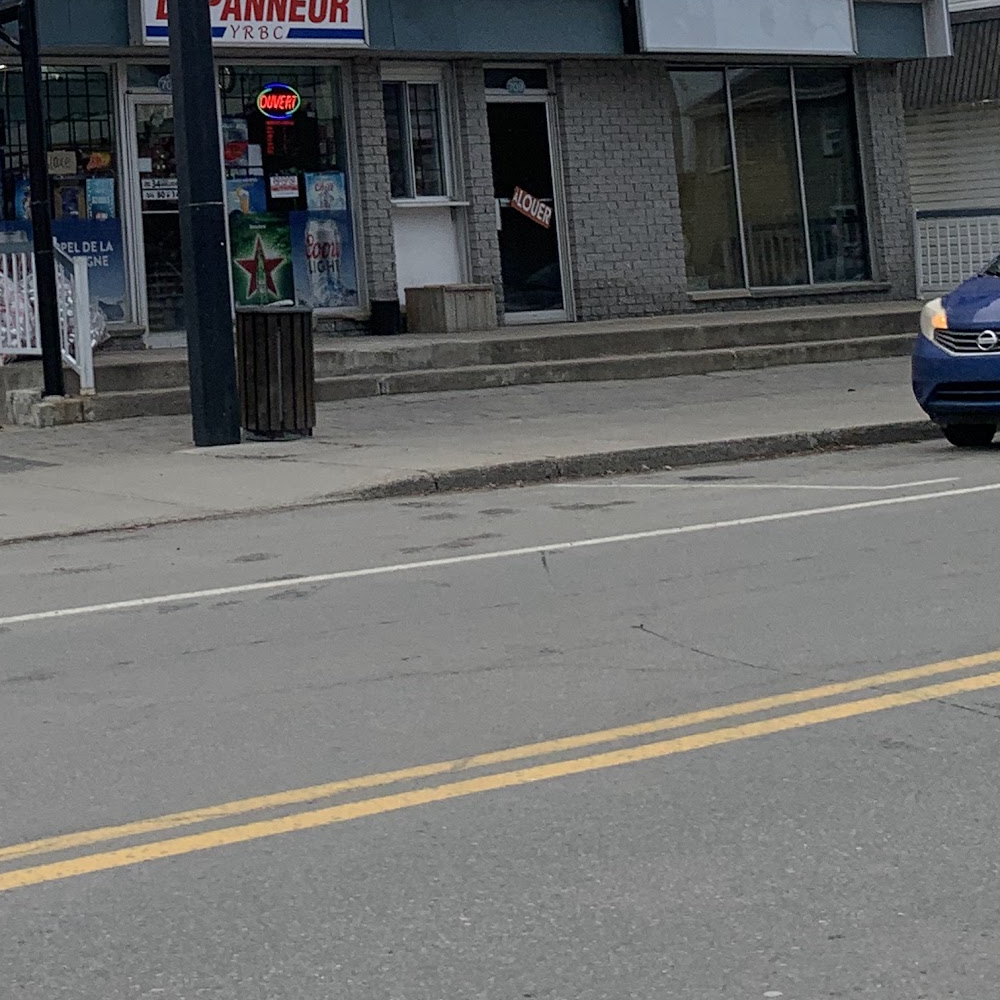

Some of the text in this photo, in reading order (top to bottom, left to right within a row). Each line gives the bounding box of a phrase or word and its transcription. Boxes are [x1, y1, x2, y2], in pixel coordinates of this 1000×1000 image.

[230, 24, 284, 40] YRBC
[259, 94, 298, 110] OUVERT
[516, 188, 552, 225] LOUER
[82, 240, 98, 253] DE
[100, 239, 114, 252] LA
